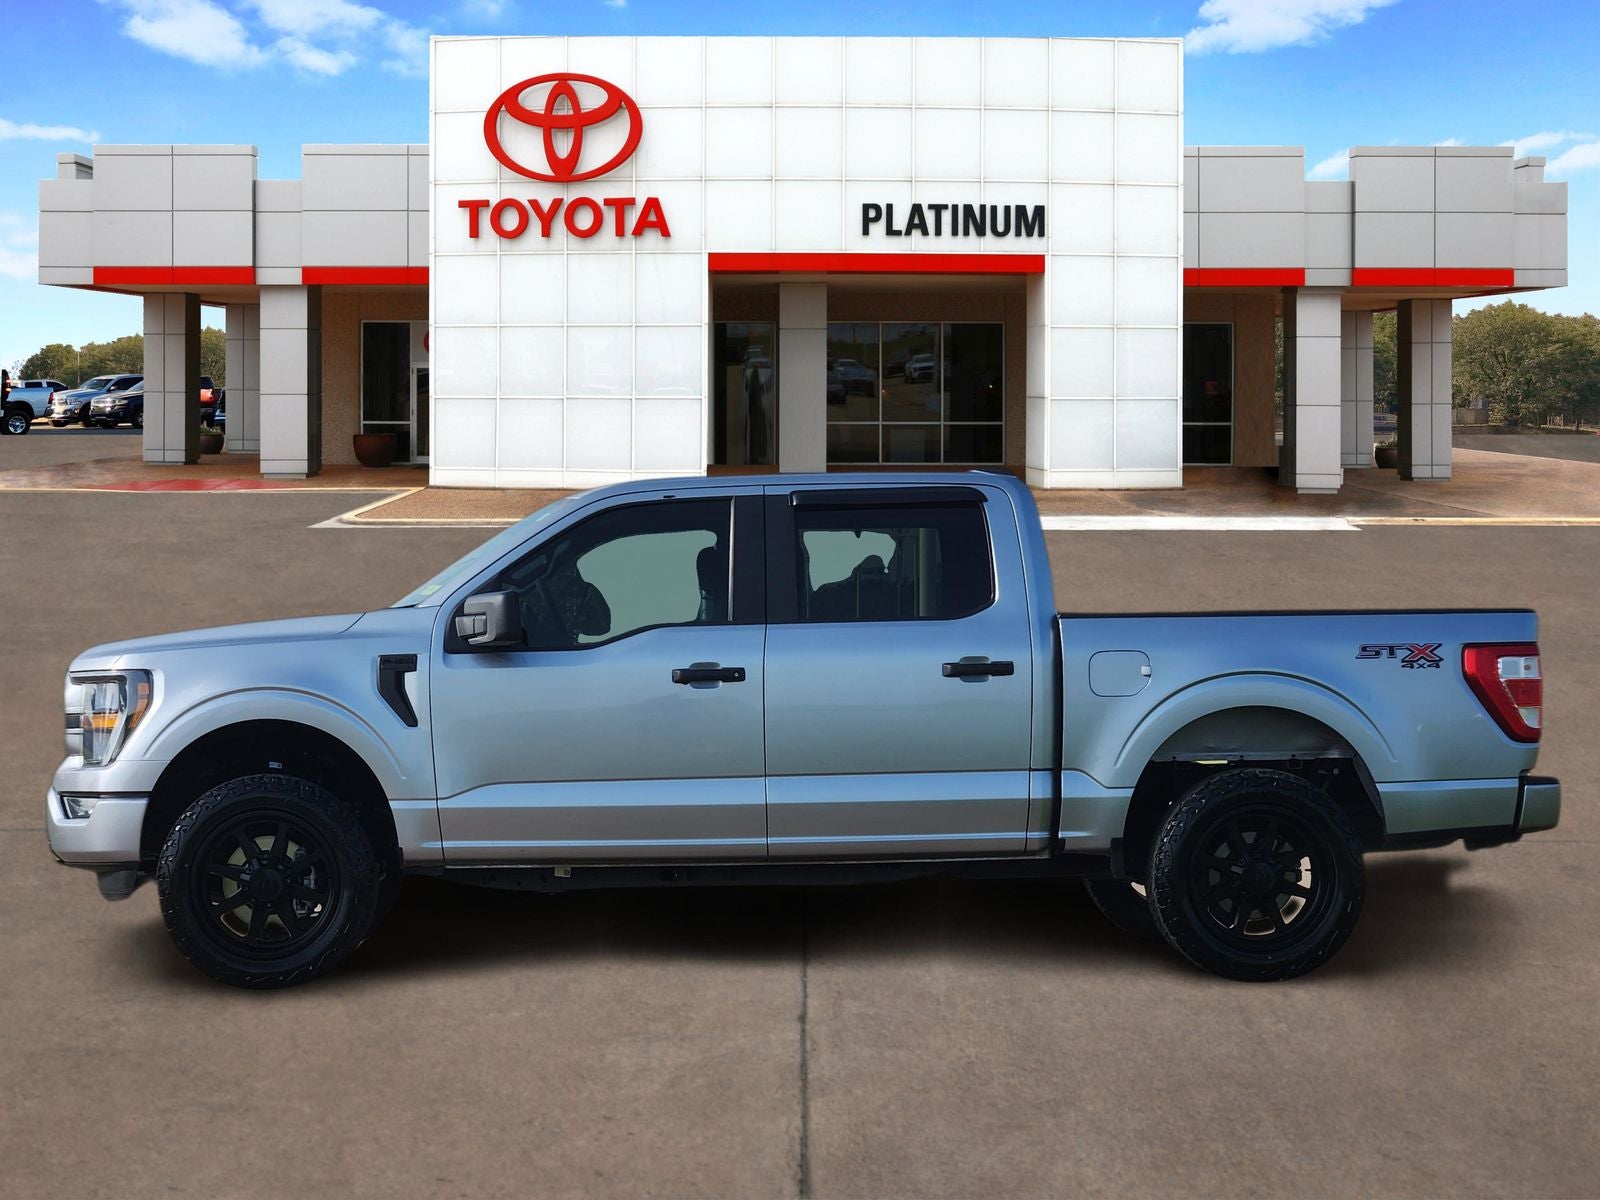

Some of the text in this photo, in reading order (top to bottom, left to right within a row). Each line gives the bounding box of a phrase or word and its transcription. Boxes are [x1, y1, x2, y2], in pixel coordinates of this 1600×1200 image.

[458, 197, 671, 239] TOYOTA
[862, 203, 1046, 238] PLATINUM
[1356, 643, 1444, 663] STX
